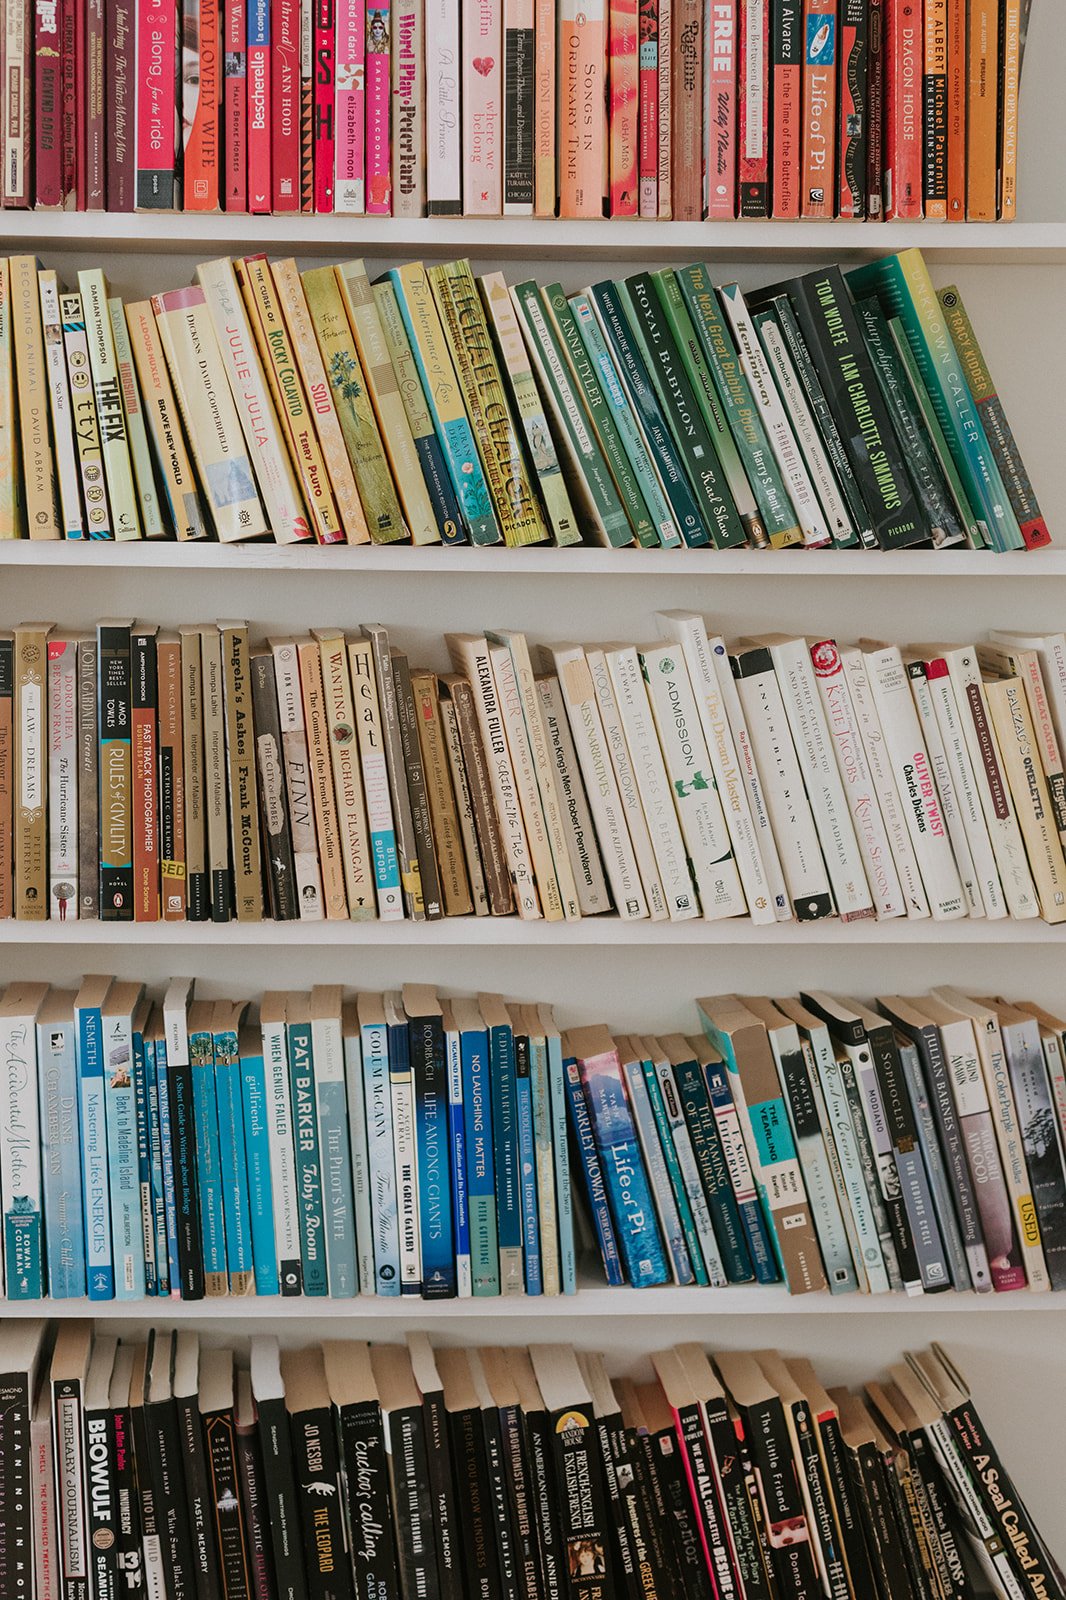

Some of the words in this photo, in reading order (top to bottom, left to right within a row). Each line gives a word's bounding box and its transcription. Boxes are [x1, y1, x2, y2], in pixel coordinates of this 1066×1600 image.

[201, 1, 214, 33] MY
[713, 5, 732, 72] FREE
[782, 8, 794, 58] Alvarez
[151, 31, 162, 75] along
[201, 40, 214, 110] LOVELY
[783, 69, 791, 79] In
[903, 29, 913, 87] DRAGON
[146, 79, 162, 98] for
[252, 52, 265, 129] Bescherelle
[569, 36, 579, 128] ORDINARY
[584, 65, 595, 124] SONGS
[782, 83, 791, 98] the
[811, 74, 827, 117] Life
[151, 102, 161, 114] the
[348, 96, 356, 144] elizabeth
[782, 102, 791, 125] Time
[903, 94, 913, 141] HOUSE
[151, 119, 164, 150] ride
[201, 121, 214, 167] WIFE
[584, 134, 592, 150] IN
[782, 128, 791, 138] of
[782, 141, 791, 156] the
[811, 121, 825, 144] of
[568, 137, 579, 179] TIME
[810, 149, 825, 170] Pi
[781, 161, 791, 212] Butterflies
[256, 268, 264, 283] THE
[261, 286, 271, 311] CURSE
[267, 313, 274, 322] OF
[815, 280, 831, 306] TOM
[824, 310, 848, 346] WOLFE
[91, 285, 101, 317] DAMIAN
[97, 318, 107, 364] THOMPSON
[268, 330, 287, 364] ROCKY
[561, 317, 582, 358] ANNE
[579, 360, 602, 407] TYLER
[635, 283, 660, 344] ROYAL
[659, 351, 696, 436] BABYLON
[186, 314, 200, 353] DICKENS
[199, 361, 212, 390] DAVID
[208, 392, 228, 453] COPPERFIELD
[279, 368, 303, 416] COLAVITO
[840, 364, 858, 380] AM
[96, 377, 119, 412] THE
[311, 384, 331, 414] SOLD
[848, 382, 881, 450] CHARLOTTE
[76, 400, 100, 456] ttyl
[101, 412, 125, 443] FIX
[158, 399, 169, 428] BRAVE
[164, 431, 174, 451] NEW
[171, 452, 182, 485] WORLD
[299, 430, 311, 460] TERRY
[309, 465, 322, 497] PLUTO
[602, 417, 610, 434] The
[607, 437, 625, 478] Beginner's
[621, 475, 639, 510] Goodbye
[870, 451, 901, 510] SIMMONS
[505, 518, 536, 531] PICADOR
[701, 470, 719, 502] Karl
[714, 505, 729, 538] Shaw
[888, 522, 914, 537] PICADOR
[231, 635, 244, 702] Angela's
[118, 701, 126, 726] AMOR
[476, 656, 495, 714] ALEXANDRA
[488, 718, 504, 754] FULLER
[666, 680, 694, 766] ADMISSION
[143, 724, 151, 742] FAST
[236, 710, 244, 755] Ashes
[969, 689, 983, 728] READING
[979, 730, 990, 763] LOLITA
[992, 780, 1006, 814] TEHRAN
[110, 749, 124, 787] RULES
[143, 745, 151, 772] TRACK
[330, 652, 345, 720] WANTING
[340, 750, 355, 806] RICHARD
[348, 814, 364, 884] FLANAGAN
[743, 746, 753, 774] Bradbury
[751, 778, 763, 814] Fahrenheit
[60, 775, 68, 826] Hurricane
[114, 790, 124, 803] of
[239, 766, 249, 808] Frank
[904, 765, 916, 799] Charles
[912, 800, 926, 832] Dickens
[913, 752, 932, 799] OLIVER
[926, 801, 944, 837] TWIST
[111, 804, 124, 856] CIVILITY
[144, 776, 152, 852] PHOTOGRAPHER
[241, 814, 251, 875] McCourt
[376, 840, 386, 881] BUFORD
[86, 1016, 96, 1065] NEMETH
[272, 1036, 280, 1062] WHEN
[294, 1036, 309, 1070] PAT
[274, 1066, 282, 1102] GENIUS
[472, 1056, 480, 1072] NO
[246, 1076, 260, 1137] girlfriends
[424, 1092, 436, 1120] LIFE
[472, 1076, 482, 1132] LAUGHING
[868, 1090, 883, 1132] MODIANO
[882, 1053, 906, 1130] SOPHOCLES
[277, 1104, 286, 1135] FAILED
[296, 1078, 313, 1151] BARKER
[760, 1108, 776, 1162] YEARLING
[770, 1105, 779, 1126] THE
[402, 1164, 410, 1184] THE
[426, 1123, 440, 1182] AMONG
[475, 1138, 484, 1178] MATTER
[611, 1142, 634, 1186] Life
[303, 1164, 320, 1210] Toby's
[403, 1188, 412, 1219] GREAT
[621, 1190, 636, 1209] of
[428, 1185, 441, 1240] GIANTS
[628, 1214, 647, 1235] Pi
[1021, 1202, 1037, 1240] USED
[306, 1211, 320, 1260] Room
[404, 1221, 413, 1252] GATSBY
[64, 1404, 75, 1475] LITERARY
[304, 1424, 318, 1436] JO
[564, 1438, 583, 1446] HOUSE
[88, 1419, 111, 1521] BEOWULF
[356, 1441, 378, 1499] cuckoo's
[761, 1412, 770, 1434] The
[766, 1437, 777, 1469] Little
[773, 1473, 788, 1512] Friend
[120, 1489, 131, 1534] INNUMERACY
[193, 1498, 202, 1531] TASTE,
[314, 1507, 328, 1527] THE
[807, 1454, 832, 1542] Regeneration
[973, 1455, 990, 1471] A
[982, 1472, 1012, 1512] Seal
[1001, 1510, 1039, 1570] Called
[66, 1481, 80, 1572] JOURNALISM
[358, 1503, 382, 1561] calling
[196, 1534, 208, 1573] MEMORY
[315, 1529, 334, 1573] LEOPARD
